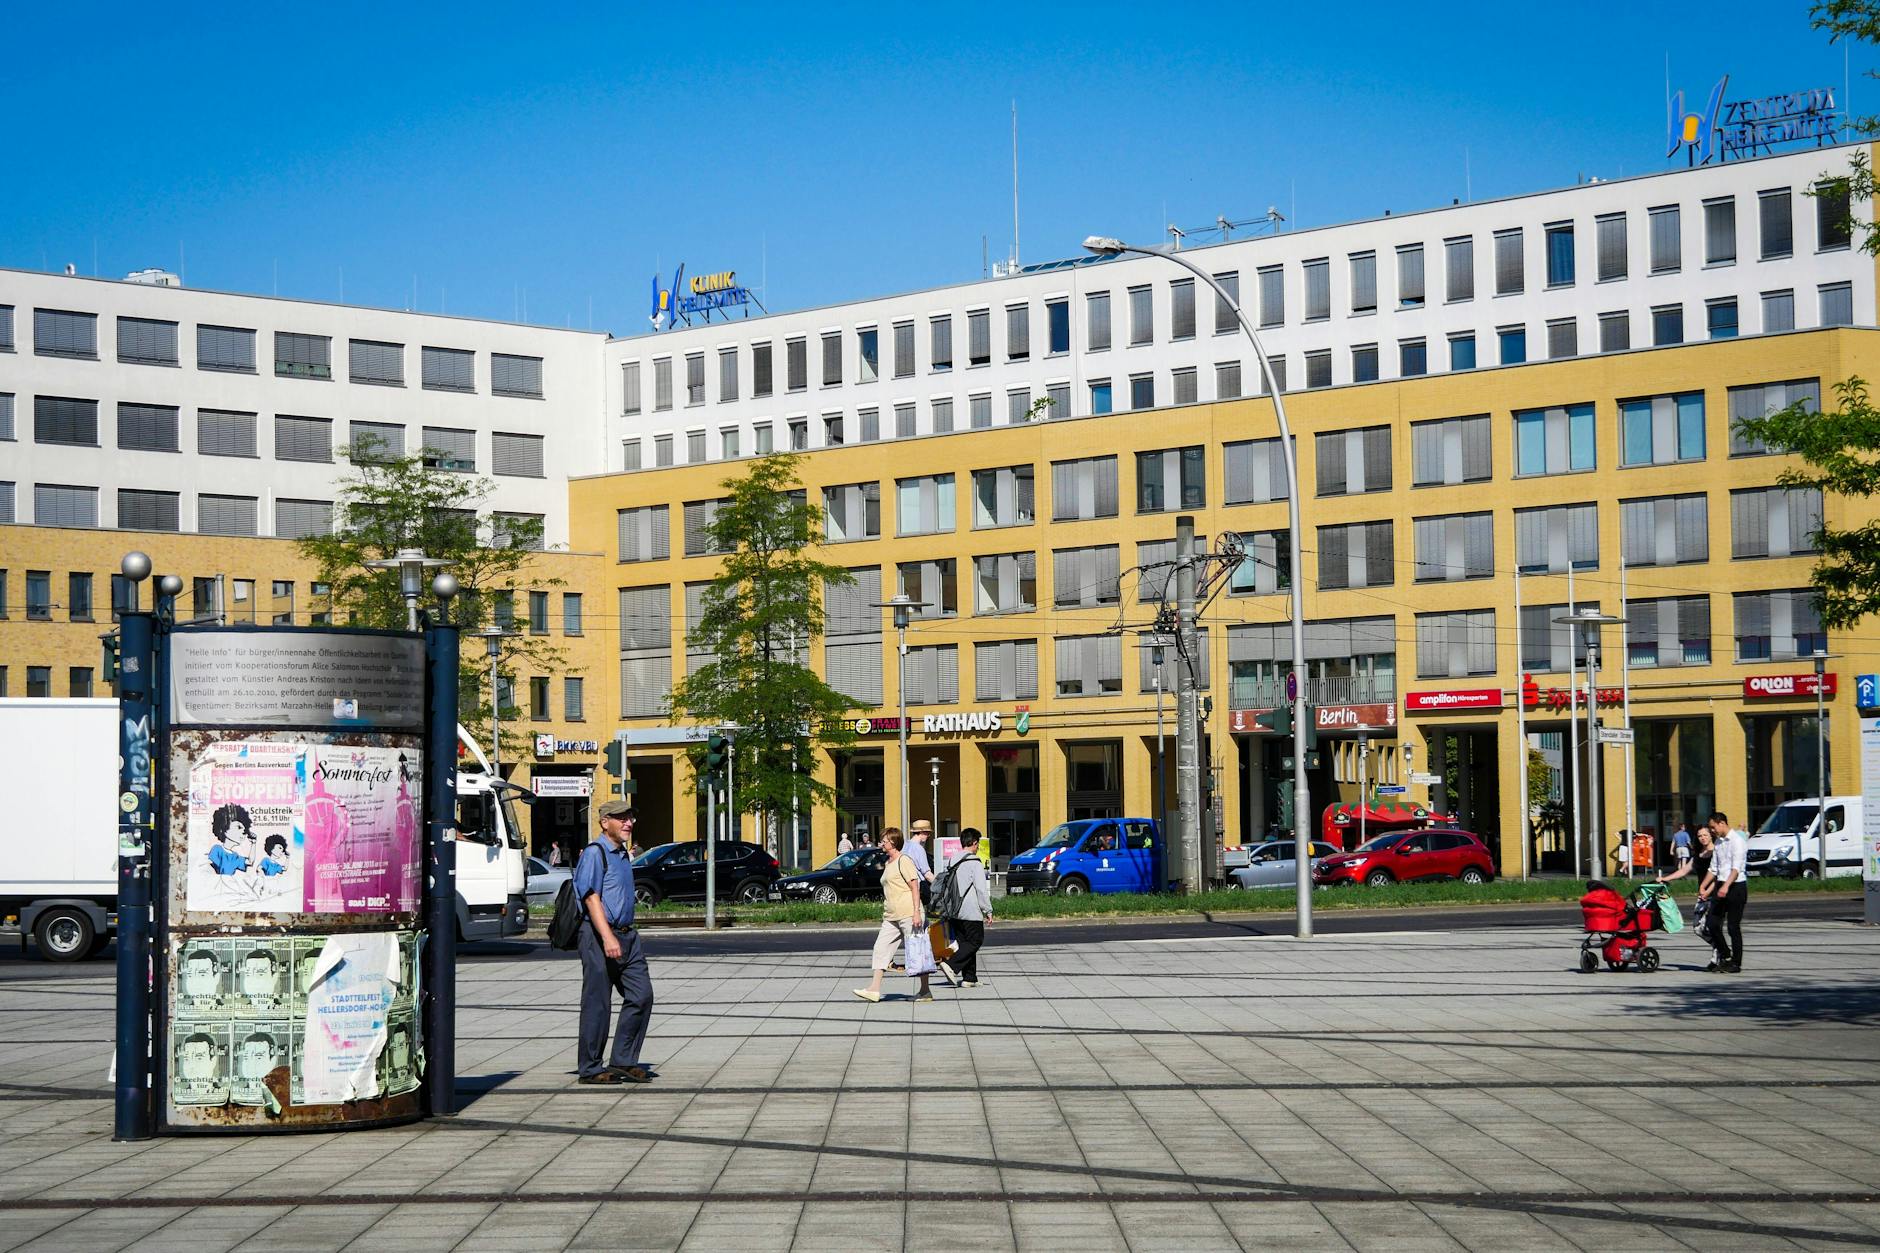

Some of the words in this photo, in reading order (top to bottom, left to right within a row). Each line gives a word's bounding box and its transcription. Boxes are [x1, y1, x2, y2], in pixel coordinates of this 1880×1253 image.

[1723, 87, 1836, 125] ZENTRUM
[690, 271, 735, 294] KLINIK
[185, 648, 209, 656] "Helle
[212, 648, 232, 656] Info"
[235, 648, 246, 656] für
[250, 648, 316, 658] bürger/innennahe
[235, 662, 310, 672] Kooperationsforum
[332, 662, 360, 671] Salomon
[185, 675, 218, 684] gestaltet
[242, 675, 274, 683] Künstler
[277, 675, 308, 683] Andreas
[1750, 677, 1794, 692] ORION
[185, 688, 214, 696] enthüllt
[233, 690, 278, 698] 26.10.2010,
[280, 688, 314, 698] gefördert
[1420, 694, 1458, 706] amplifon
[185, 702, 232, 712] Eigentümer:
[234, 702, 278, 710] Bezirksamt
[280, 702, 335, 710] Marzahn-Helle
[1320, 708, 1358, 724] Berlin
[924, 712, 1000, 733] RATHAUS
[312, 760, 392, 791] Sommerfest
[214, 783, 293, 800] STOPPEN!
[250, 806, 293, 814] Schulstreik
[331, 994, 380, 1003] STADTTEILFEST
